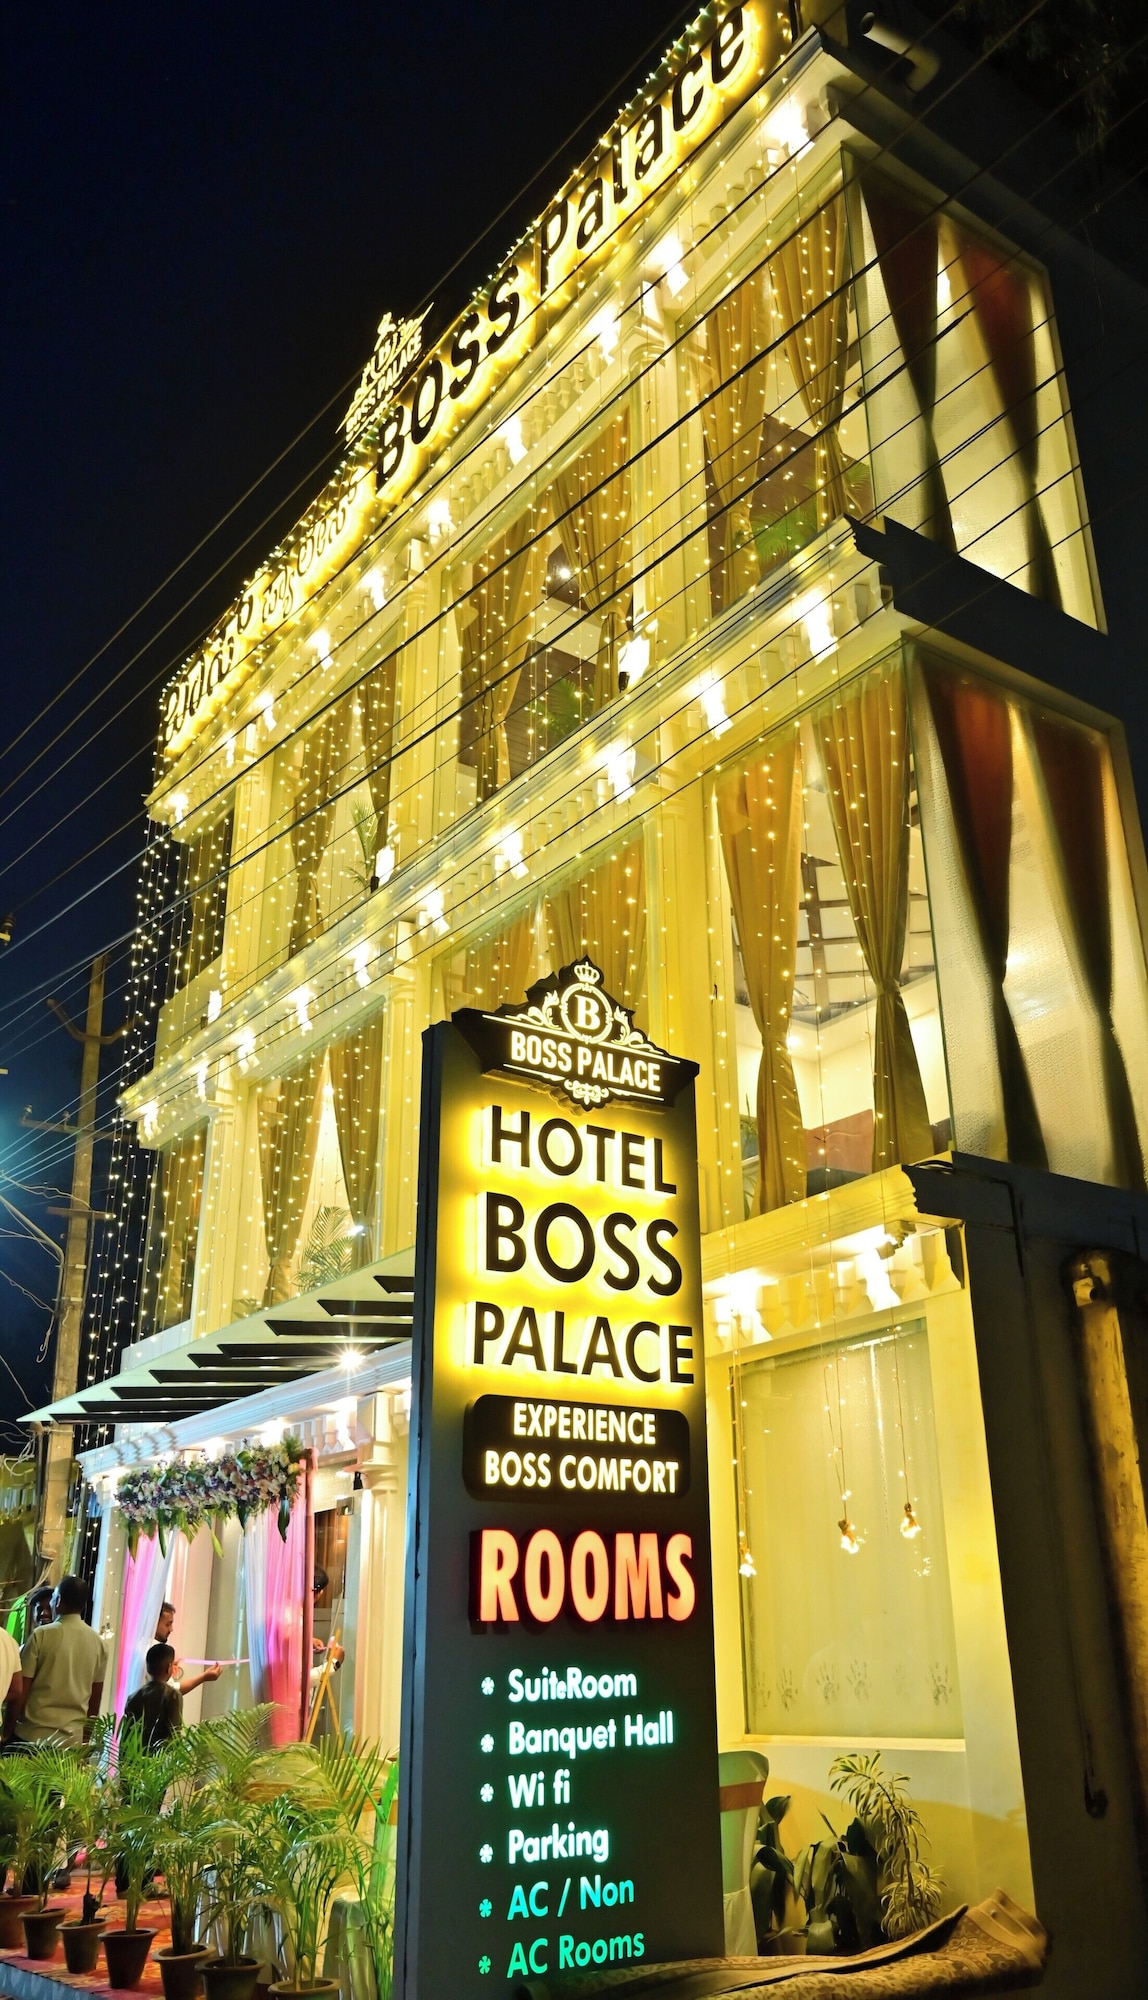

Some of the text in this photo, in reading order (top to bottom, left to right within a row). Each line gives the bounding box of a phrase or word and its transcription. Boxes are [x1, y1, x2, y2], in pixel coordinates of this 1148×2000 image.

[375, 5, 744, 492] BOSS Palace
[377, 325, 422, 400] PALACE
[574, 994, 600, 1031] B
[511, 1030, 661, 1093] BOSS PALACE
[491, 1105, 677, 1195] HOTEL
[486, 1191, 683, 1297] BOSS
[473, 1301, 695, 1384] PALACE
[513, 1402, 657, 1445] EXPERIENCE
[485, 1450, 679, 1494] BOSS COMFORT
[480, 1529, 696, 1623] ROOMS
[508, 1710, 674, 1760] Banquet Hall
[508, 1769, 571, 1808] Wi fi
[508, 1821, 609, 1864] Parking
[507, 1874, 635, 1920] AC / Non
[507, 1932, 645, 1978] AC Rooms
